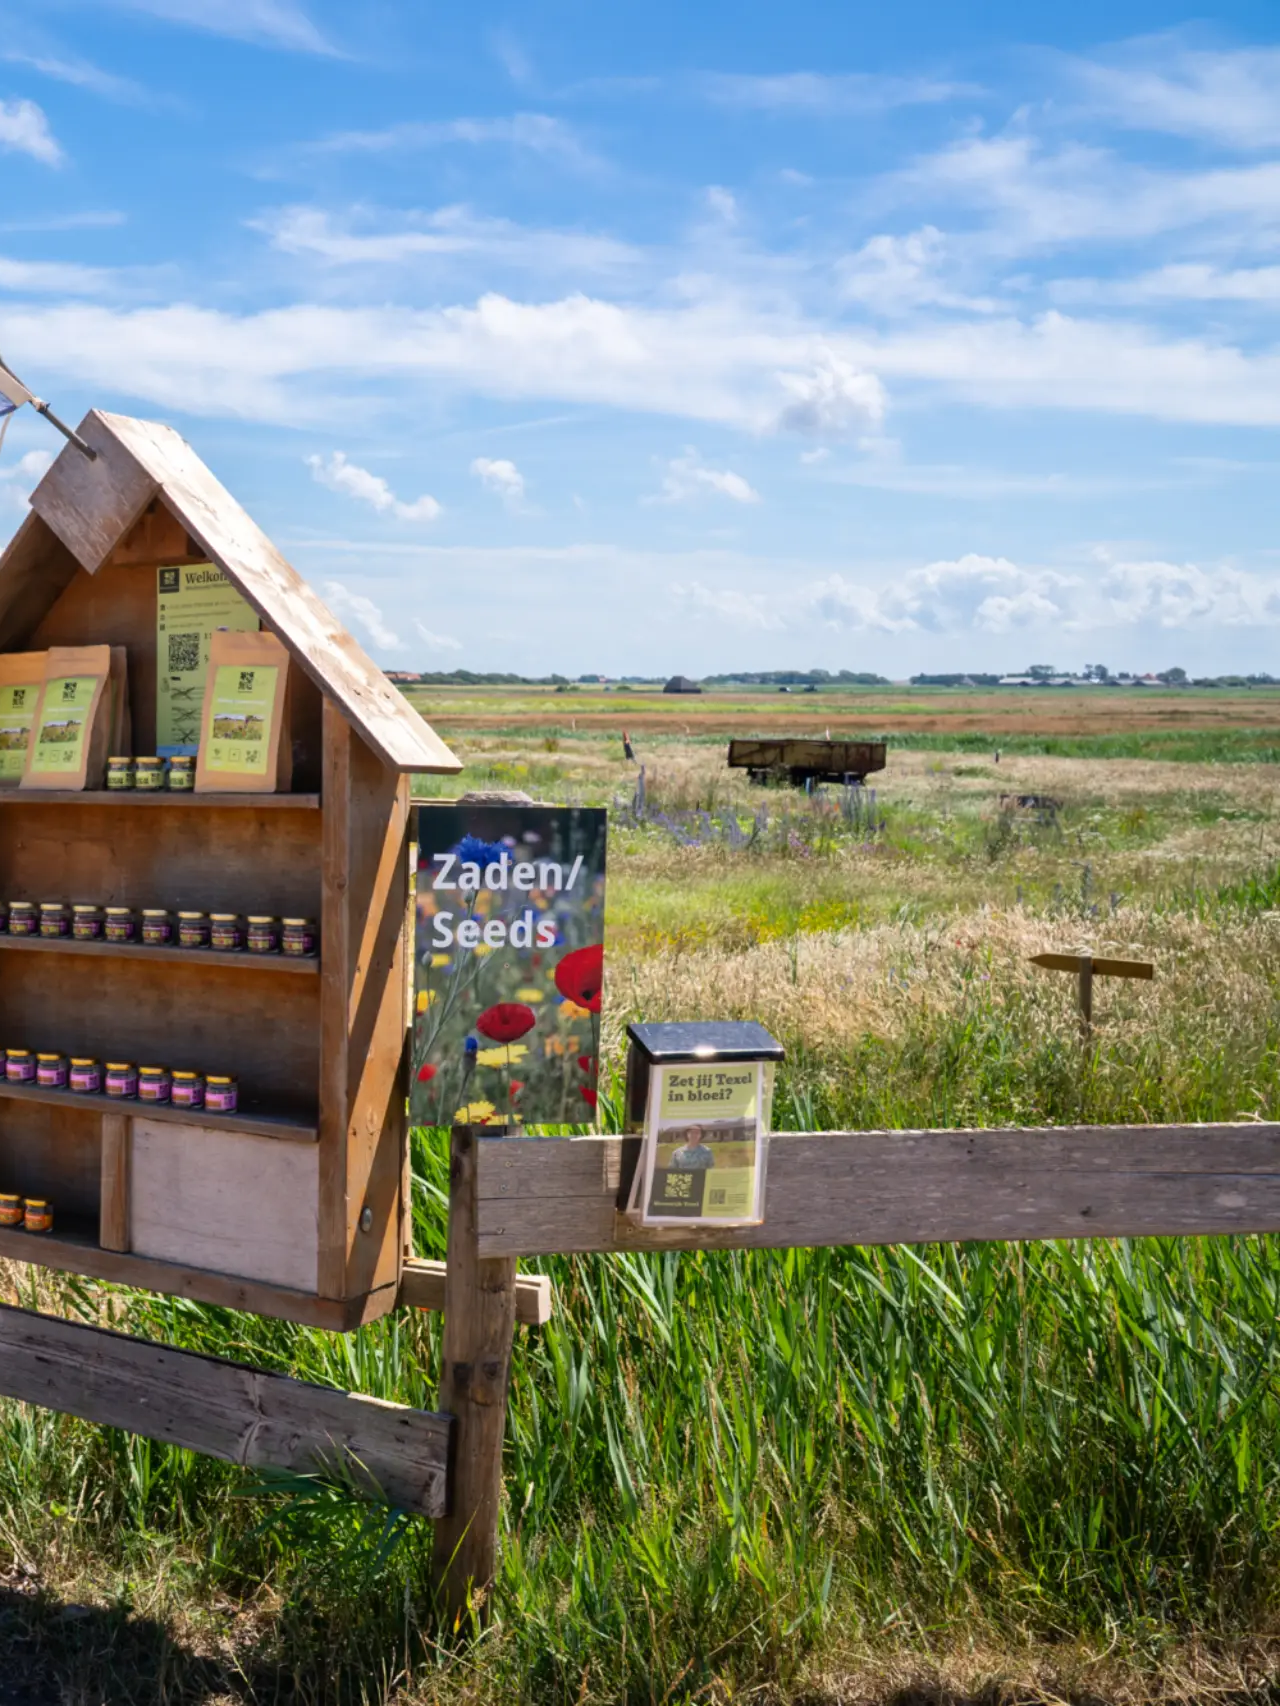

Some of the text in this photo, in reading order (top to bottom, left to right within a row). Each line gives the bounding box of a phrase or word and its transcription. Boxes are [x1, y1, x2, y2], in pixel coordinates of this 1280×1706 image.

[432, 852, 585, 891] Zaden/
[432, 910, 556, 948] Seeds
[669, 1072, 753, 1088] Zet jij Texel
[668, 1088, 733, 1102] in bloei?
